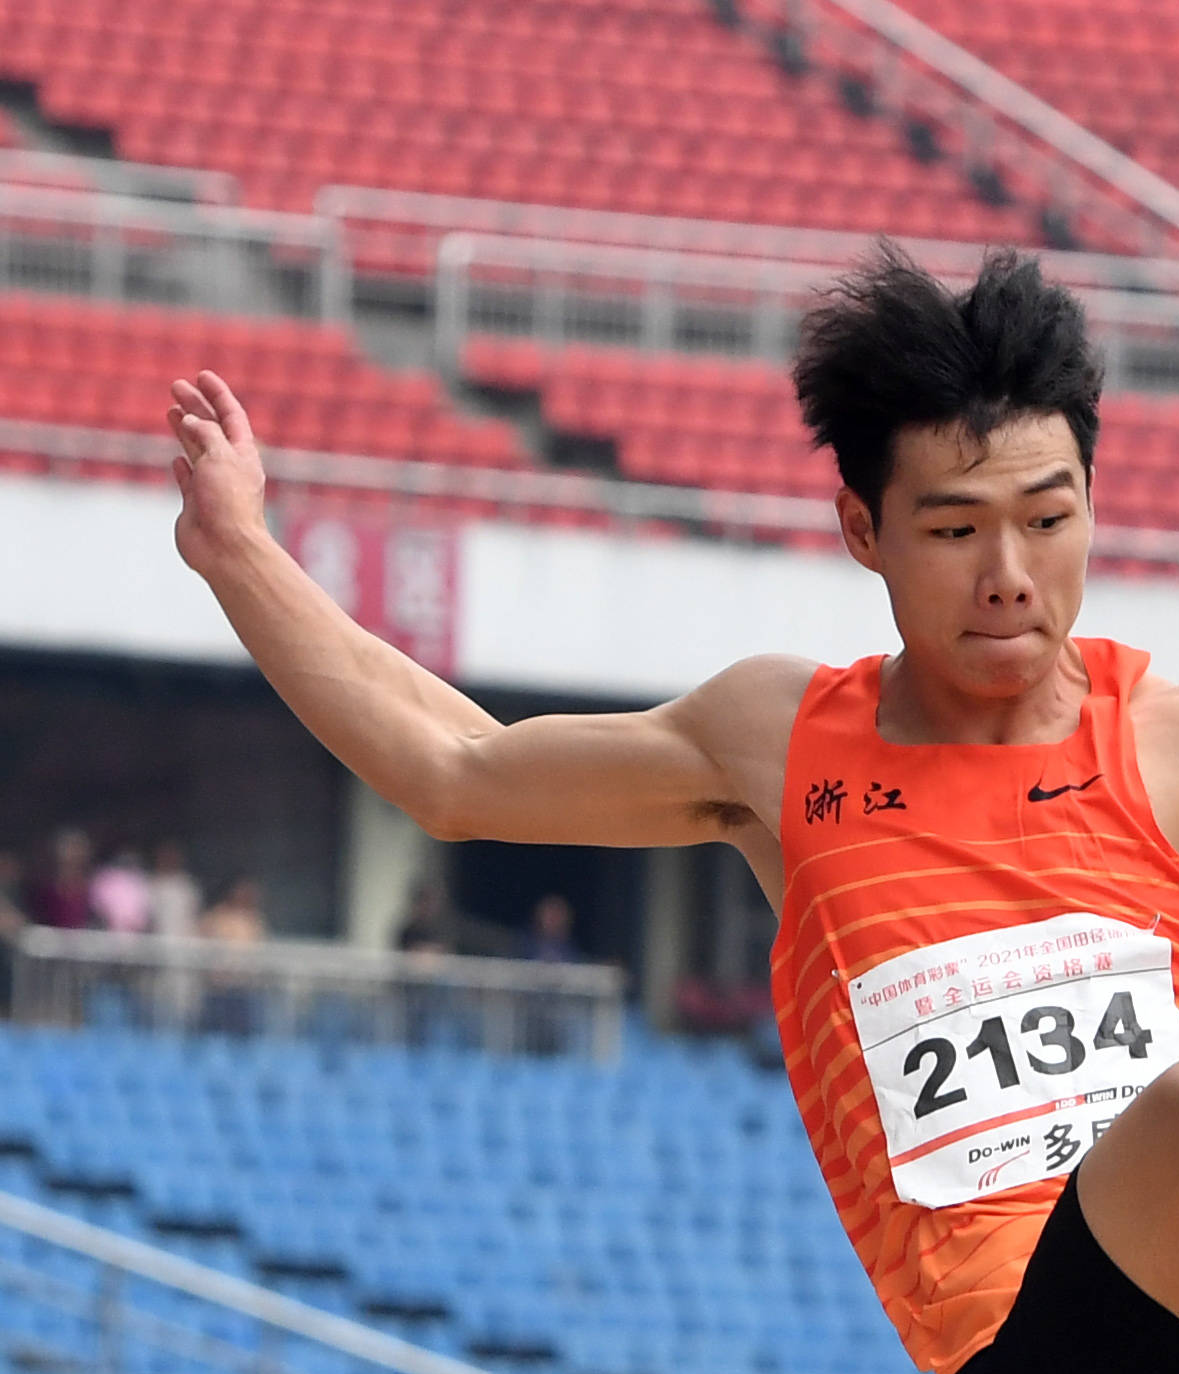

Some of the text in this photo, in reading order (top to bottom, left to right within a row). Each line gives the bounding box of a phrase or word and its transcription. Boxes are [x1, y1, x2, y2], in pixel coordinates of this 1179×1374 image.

[804, 778, 907, 825] 浙江
[976, 926, 1136, 970] 2021年全国田径
[902, 990, 1153, 1121] 2134
[1091, 1089, 1115, 1104] WIN
